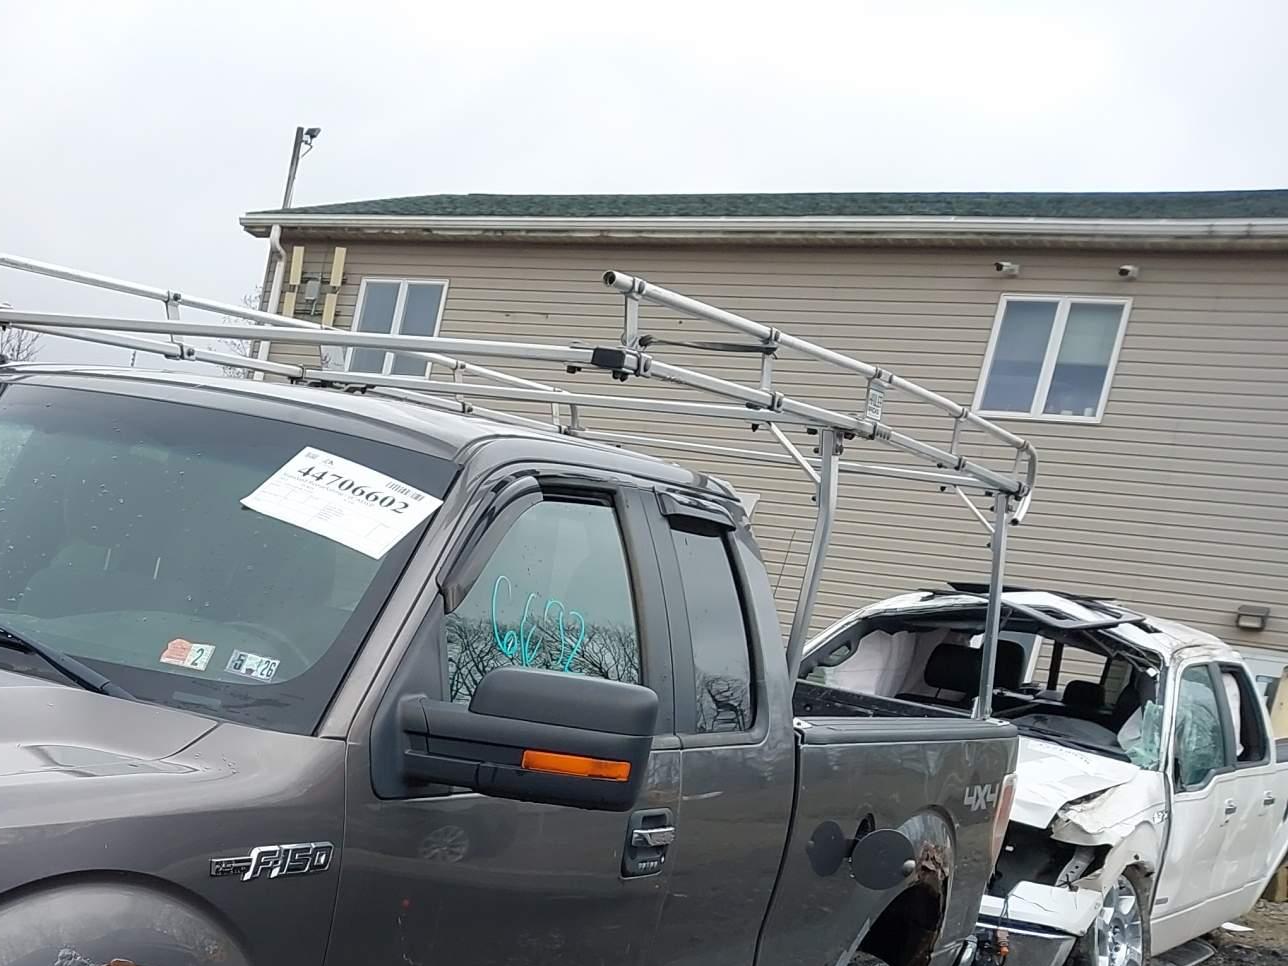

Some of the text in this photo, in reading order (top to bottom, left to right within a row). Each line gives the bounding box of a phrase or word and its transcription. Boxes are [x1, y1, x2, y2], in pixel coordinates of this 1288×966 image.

[298, 466, 410, 514] 44706602
[190, 647, 205, 667] 2
[233, 654, 245, 670] 5
